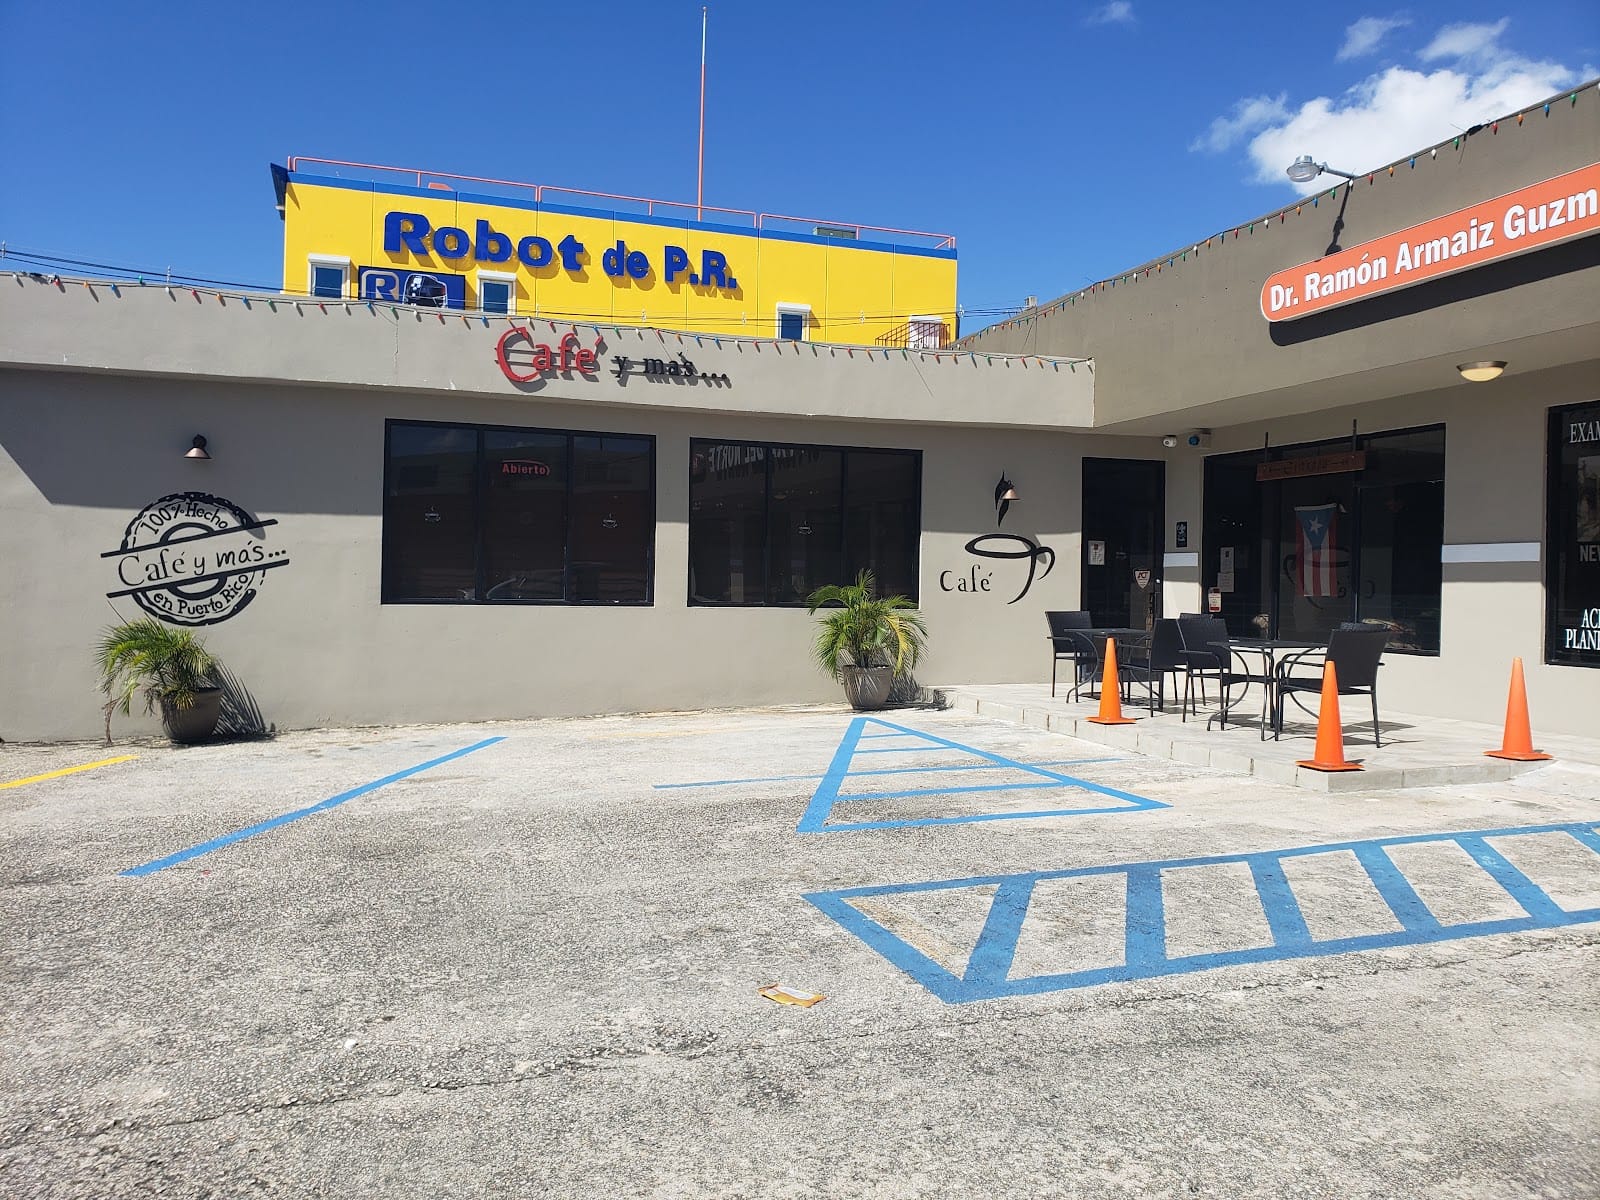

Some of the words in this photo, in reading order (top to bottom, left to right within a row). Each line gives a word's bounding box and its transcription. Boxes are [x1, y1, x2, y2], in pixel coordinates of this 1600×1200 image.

[384, 211, 584, 271] Robot
[602, 240, 649, 279] de
[664, 245, 737, 289] P.R.
[1270, 284, 1299, 312] Dr.
[1304, 253, 1387, 302] Ramón
[1394, 218, 1495, 275] Armaiz
[1503, 188, 1598, 240] Guzm
[496, 327, 603, 382] Café
[614, 355, 627, 378] y
[502, 463, 546, 475] Abierto
[140, 504, 185, 535] 100%
[185, 502, 228, 529] Hecho
[118, 549, 187, 587] Café
[194, 556, 205, 576] y
[939, 564, 993, 593] Café
[153, 592, 174, 611] en
[178, 598, 224, 615] Puerto
[221, 574, 249, 604] Rico
